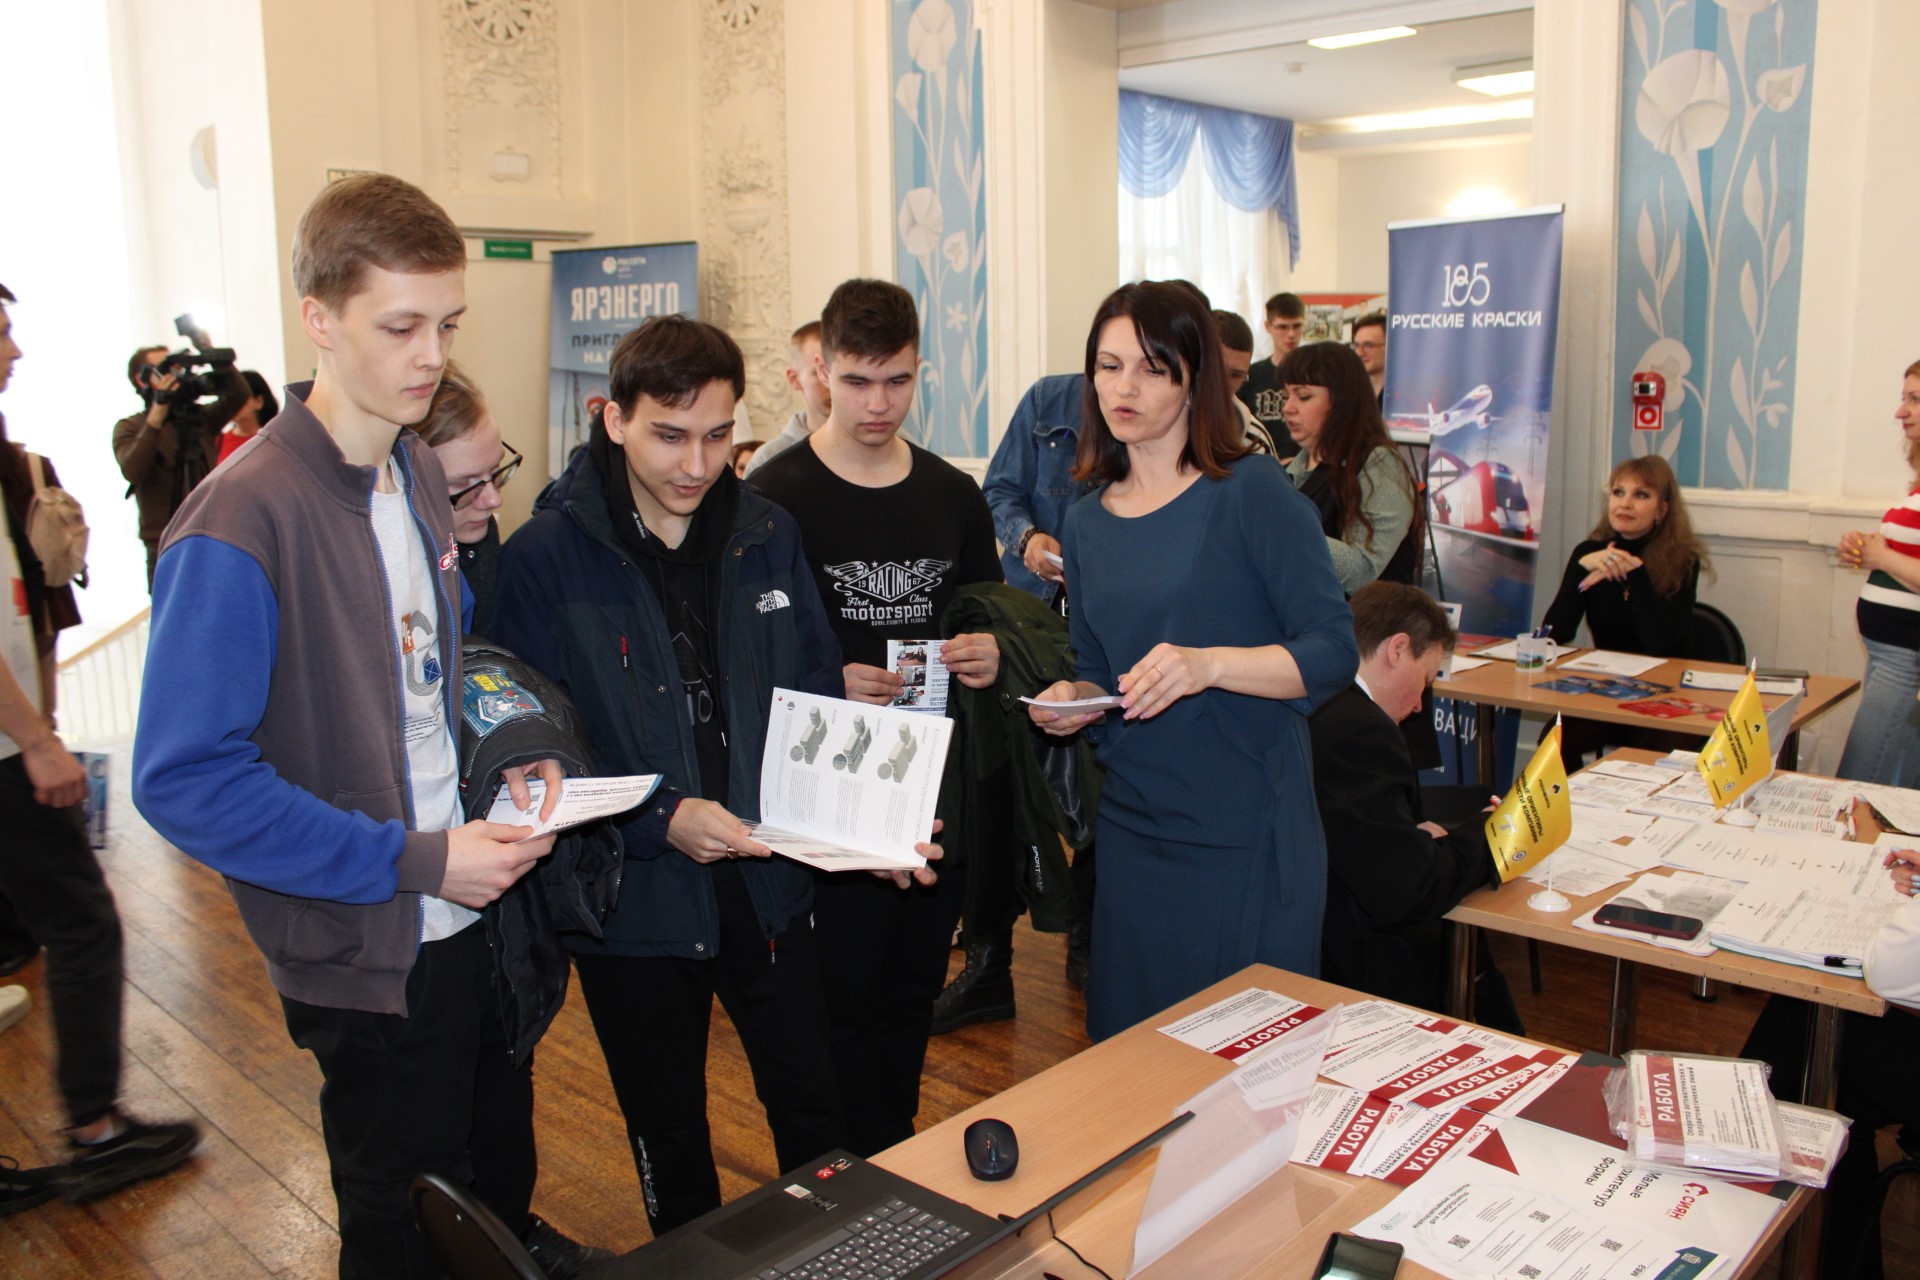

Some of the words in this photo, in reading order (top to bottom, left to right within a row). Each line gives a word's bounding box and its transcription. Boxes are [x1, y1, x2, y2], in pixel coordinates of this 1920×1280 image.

[571, 282, 679, 322] ЯРЭНЕРГО
[1391, 312, 1465, 329] РУССКИЕ
[1472, 310, 1542, 328] КРАСКИ
[572, 333, 621, 348] ПРИГЛ
[583, 351, 604, 364] НА
[760, 591, 774, 601] THE
[858, 580, 867, 588] 19
[868, 565, 912, 598] RACING
[913, 577, 921, 585] 67
[841, 601, 933, 623] motorsport
[847, 596, 869, 607] First
[910, 594, 928, 604] Class
[1522, 804, 1538, 843] КОМПАНИИ
[1527, 795, 1543, 837] ОРИЕНТИРЫ
[1234, 1017, 1302, 1050] РАБОТА
[1390, 1055, 1459, 1089] РАБОТА
[1433, 1066, 1509, 1098] РАБОТА
[1654, 1072, 1677, 1123] РАБОТА
[1334, 1107, 1381, 1156] РАБОТА
[1403, 1125, 1465, 1171] РАБОТА
[1584, 1157, 1615, 1186] формы
[1593, 1166, 1634, 1208] хитектур
[1630, 1171, 1662, 1199] Малые
[1669, 1196, 1696, 1220] СИЯН
